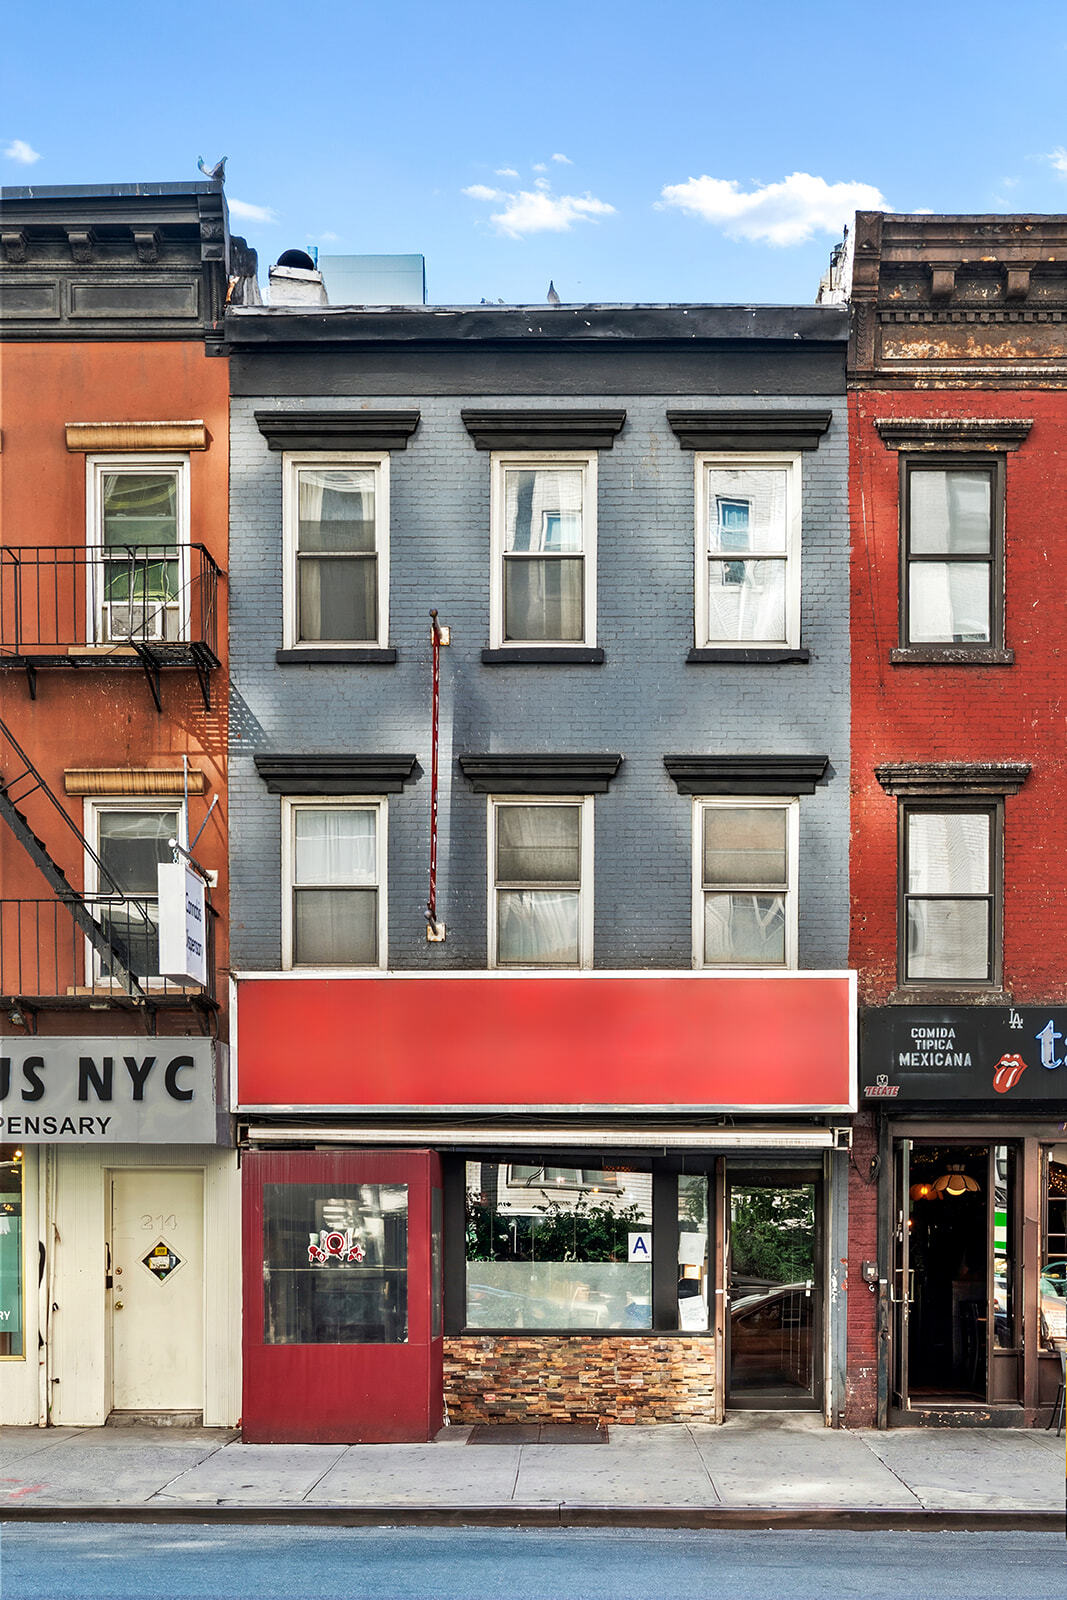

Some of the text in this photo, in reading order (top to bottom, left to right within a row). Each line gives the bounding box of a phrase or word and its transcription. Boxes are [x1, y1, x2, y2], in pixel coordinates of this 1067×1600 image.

[1009, 1008, 1024, 1029] LA
[910, 1027, 956, 1039] COMIDA
[915, 1039, 954, 1051] TIPICA
[1035, 1019, 1067, 1070] t
[899, 1052, 972, 1067] MEXICANA
[78, 1055, 194, 1102] NYC
[864, 1086, 900, 1097] TECATE
[632, 1236, 648, 1254] A
